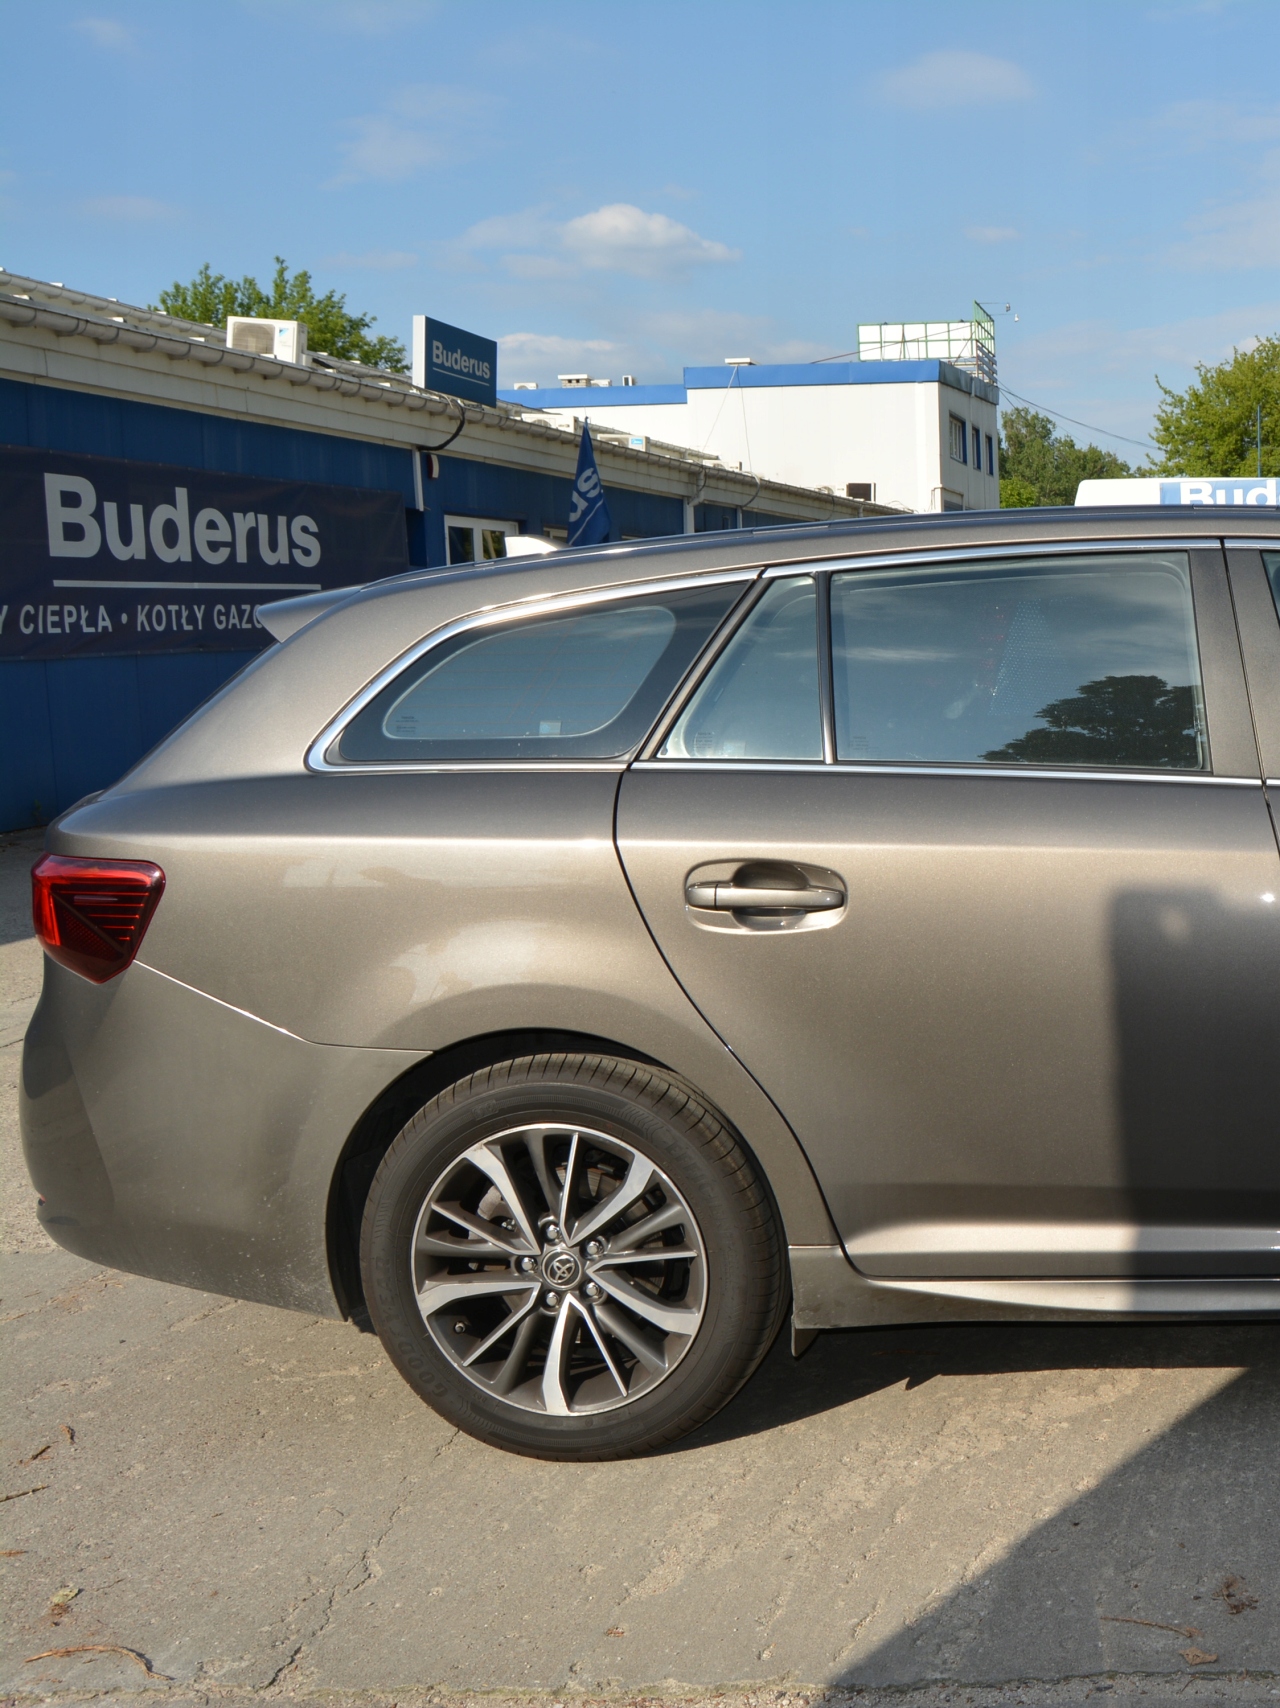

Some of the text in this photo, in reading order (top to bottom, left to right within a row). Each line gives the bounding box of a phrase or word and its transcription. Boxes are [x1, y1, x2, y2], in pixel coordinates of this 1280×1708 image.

[432, 339, 490, 379] Buderus
[44, 472, 321, 567] Buderus
[19, 604, 113, 634] CIEPŁA
[137, 604, 206, 632] KOTŁY
